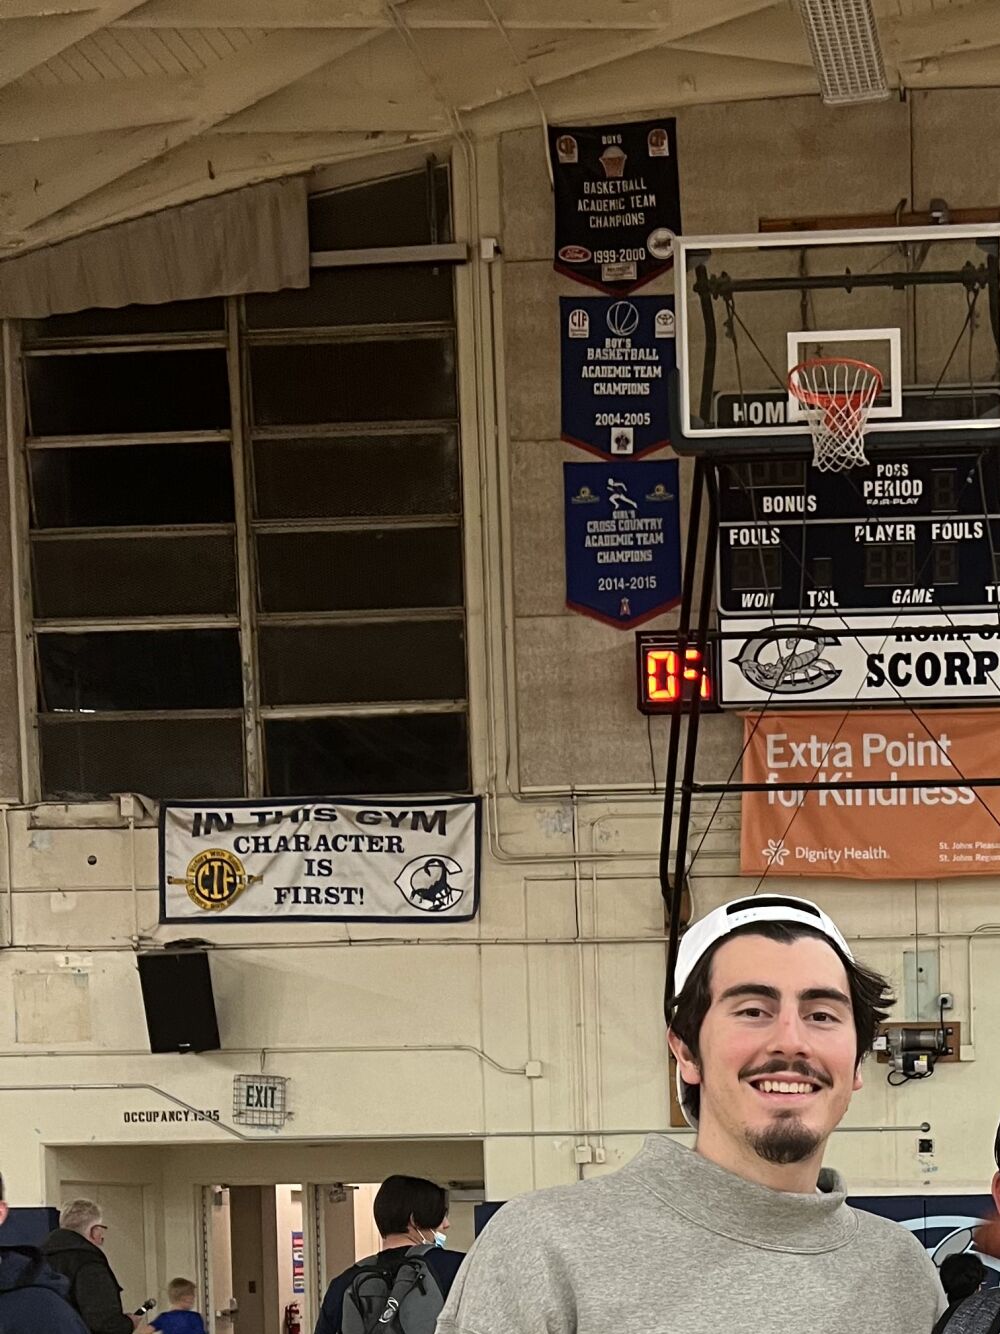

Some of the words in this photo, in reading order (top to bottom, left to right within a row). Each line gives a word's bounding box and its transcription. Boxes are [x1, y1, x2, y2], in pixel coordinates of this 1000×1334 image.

[583, 177, 648, 194] BASKETBALL
[577, 198, 625, 212] ACADEMIC
[631, 194, 656, 208] TEAM
[590, 213, 645, 228] CHAMPIONS
[594, 248, 646, 263] 1999-2000
[571, 312, 588, 328] CIF
[605, 338, 631, 349] BOY'S
[587, 347, 659, 360] BASKETBALL
[582, 366, 631, 378] ACADEMIC
[633, 366, 662, 378] TEAM
[593, 382, 650, 396] CHAMPIONS
[595, 413, 651, 427] 2004-2005
[733, 401, 799, 424] HOM
[877, 464, 909, 477] POSS
[863, 479, 923, 497] PERIOD
[762, 495, 817, 513] BONUS
[586, 520, 617, 533] CROSS
[618, 518, 663, 531] COUNTRY
[854, 525, 916, 542] PLAYER
[931, 522, 984, 540] FOULS
[585, 533, 633, 547] ACADEMIC
[635, 532, 664, 545] TEAM
[729, 527, 780, 546] FOULS
[597, 550, 653, 563] CHAMPIONS
[598, 576, 657, 591] 2014-2015
[807, 590, 839, 608] TOL
[892, 588, 935, 604] GAME
[766, 732, 852, 769] Extra
[862, 732, 952, 768] Point
[765, 772, 806, 807] for
[818, 771, 977, 807] Kindness
[191, 811, 234, 837] IN
[250, 808, 338, 828] THIS
[355, 810, 447, 836] GYM
[233, 834, 405, 855] CHARACTER
[795, 846, 841, 864] Dignity
[844, 846, 888, 861] Health
[304, 859, 333, 876] IS
[197, 861, 234, 899] CIF
[274, 886, 365, 905] FIRST!
[246, 1085, 277, 1109] EXIT
